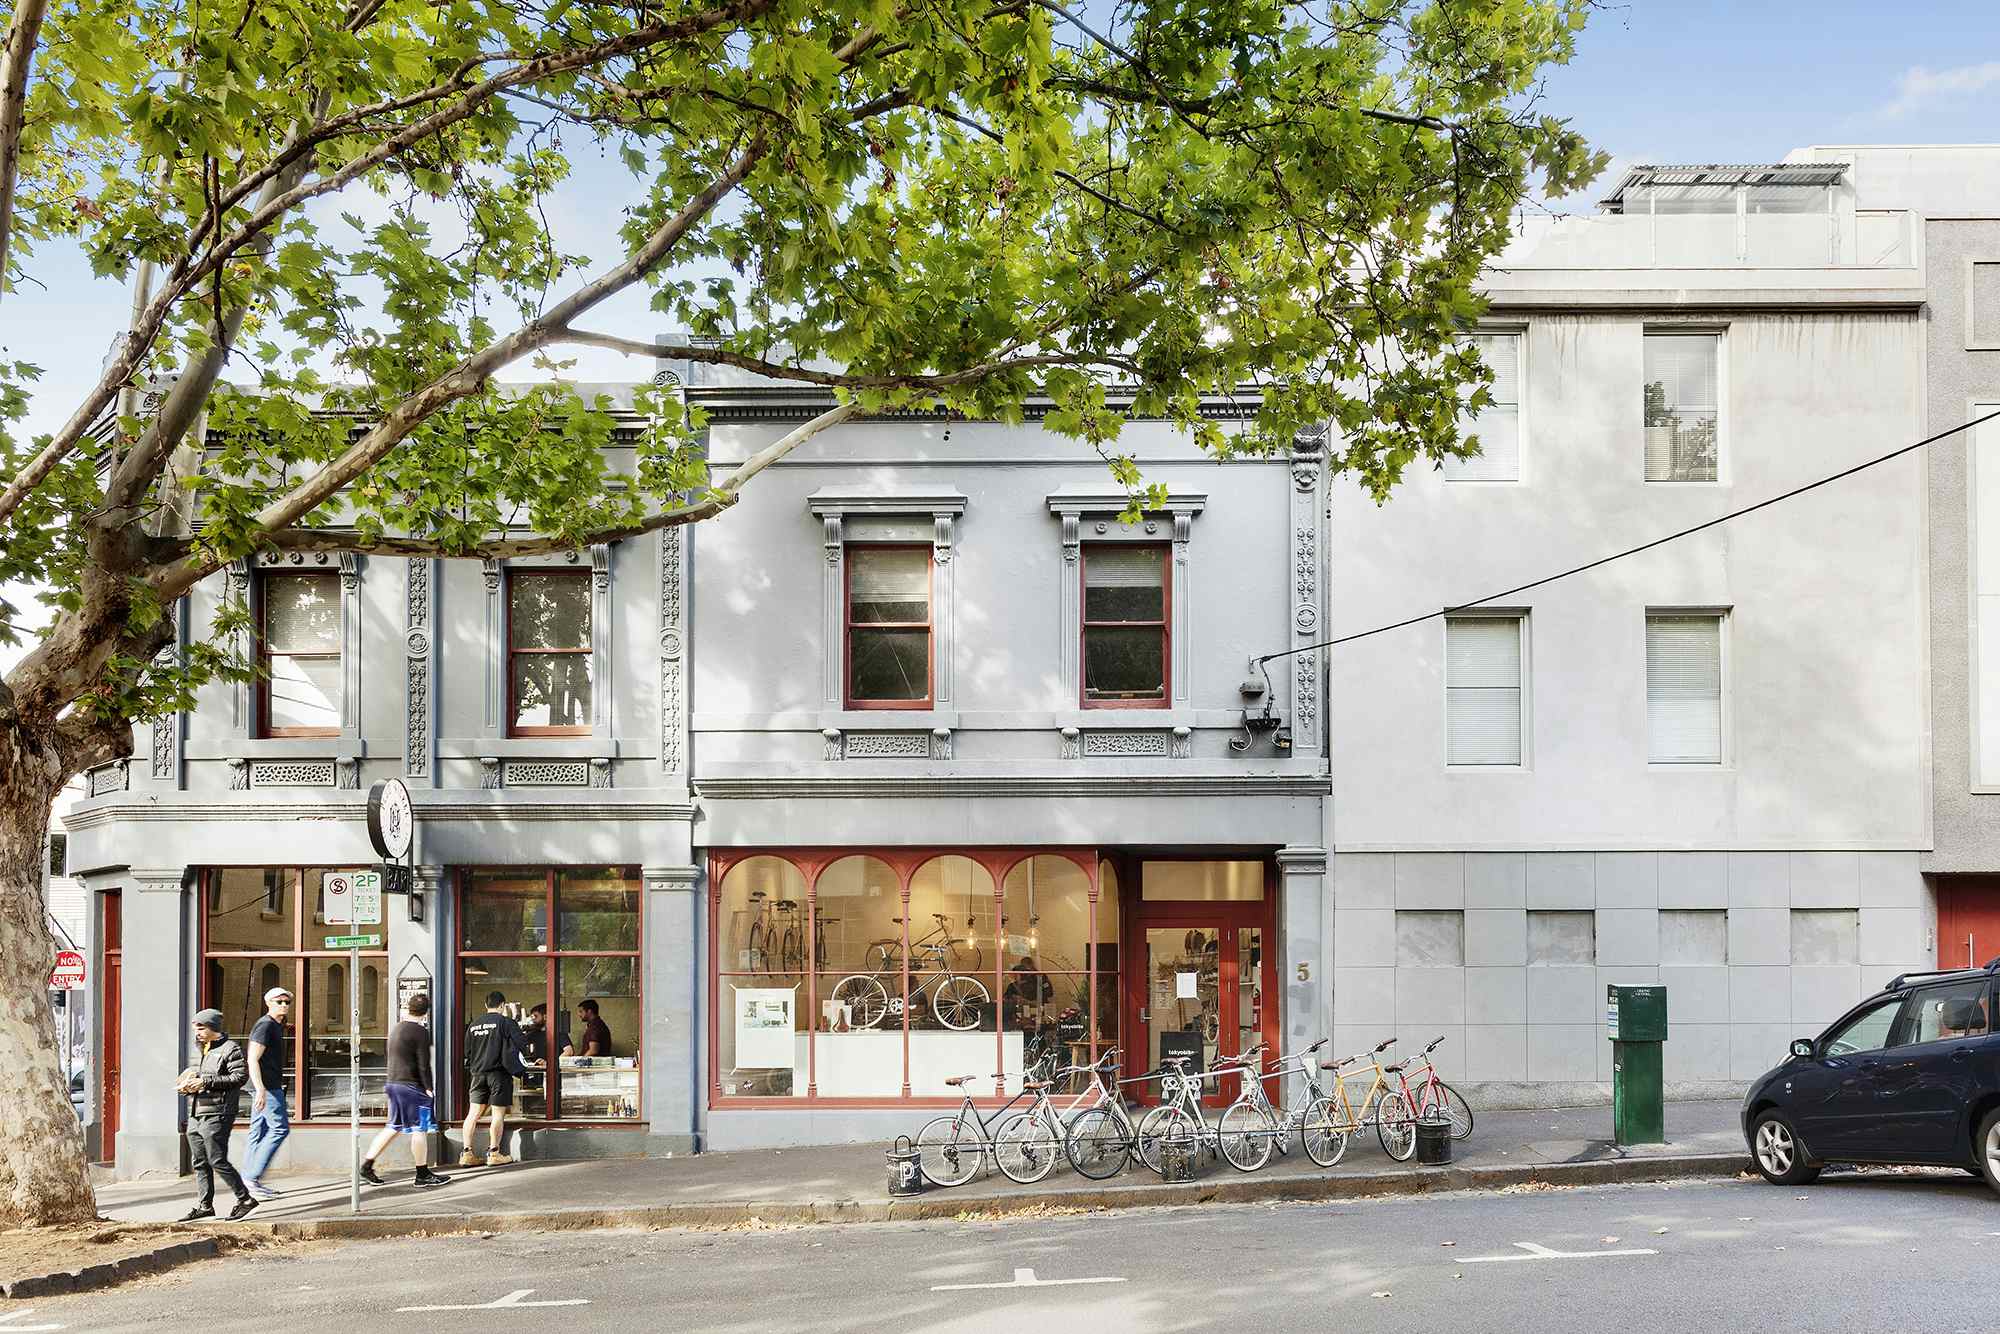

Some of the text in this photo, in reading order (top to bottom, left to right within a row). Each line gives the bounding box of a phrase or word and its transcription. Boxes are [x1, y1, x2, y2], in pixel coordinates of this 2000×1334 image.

[355, 874, 378, 887] 2P
[60, 957, 73, 966] NO
[1297, 962, 1309, 982] 5
[53, 975, 81, 983] ENTRY
[900, 1161, 914, 1188] P
